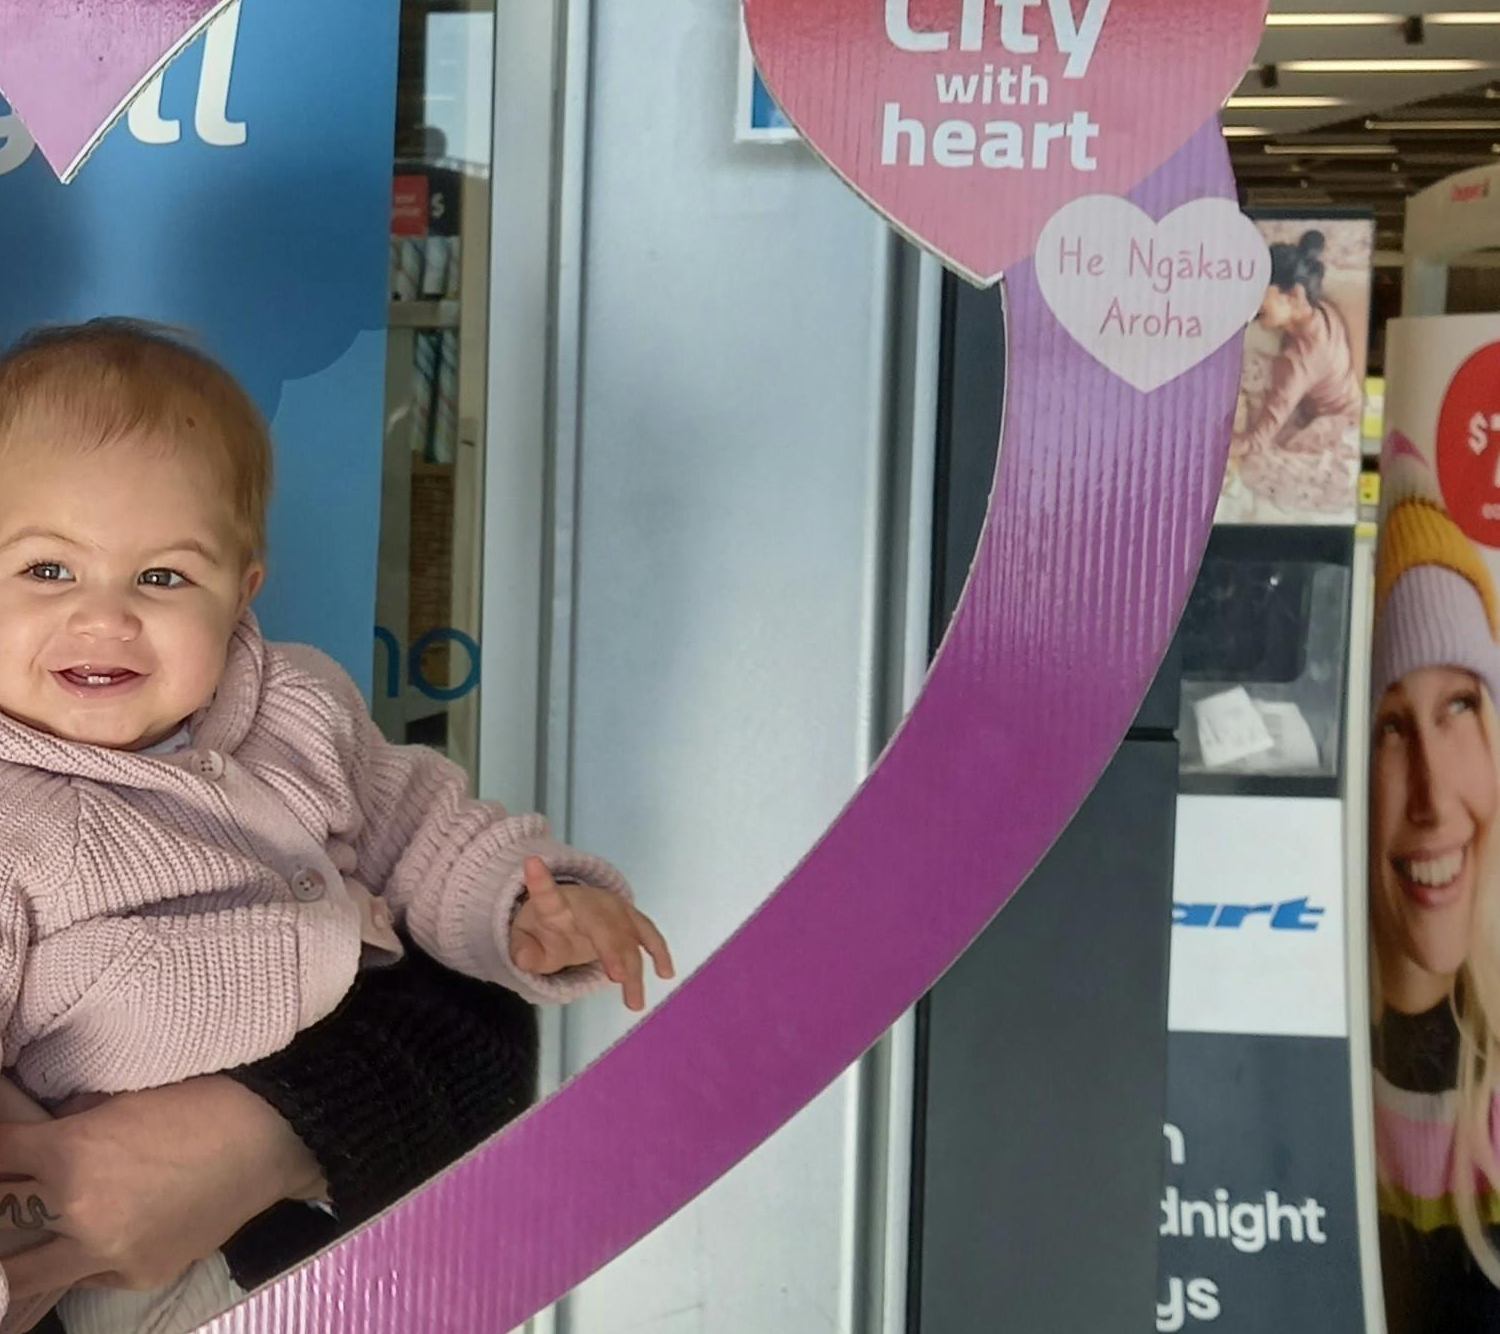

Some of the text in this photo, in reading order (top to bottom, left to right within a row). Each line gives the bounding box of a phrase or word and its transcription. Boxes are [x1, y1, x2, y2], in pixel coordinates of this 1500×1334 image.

[935, 63, 1048, 105] with
[881, 101, 1100, 171] heart
[1059, 235, 1256, 294] He Ngākau
[1099, 296, 1203, 338] Aroha
